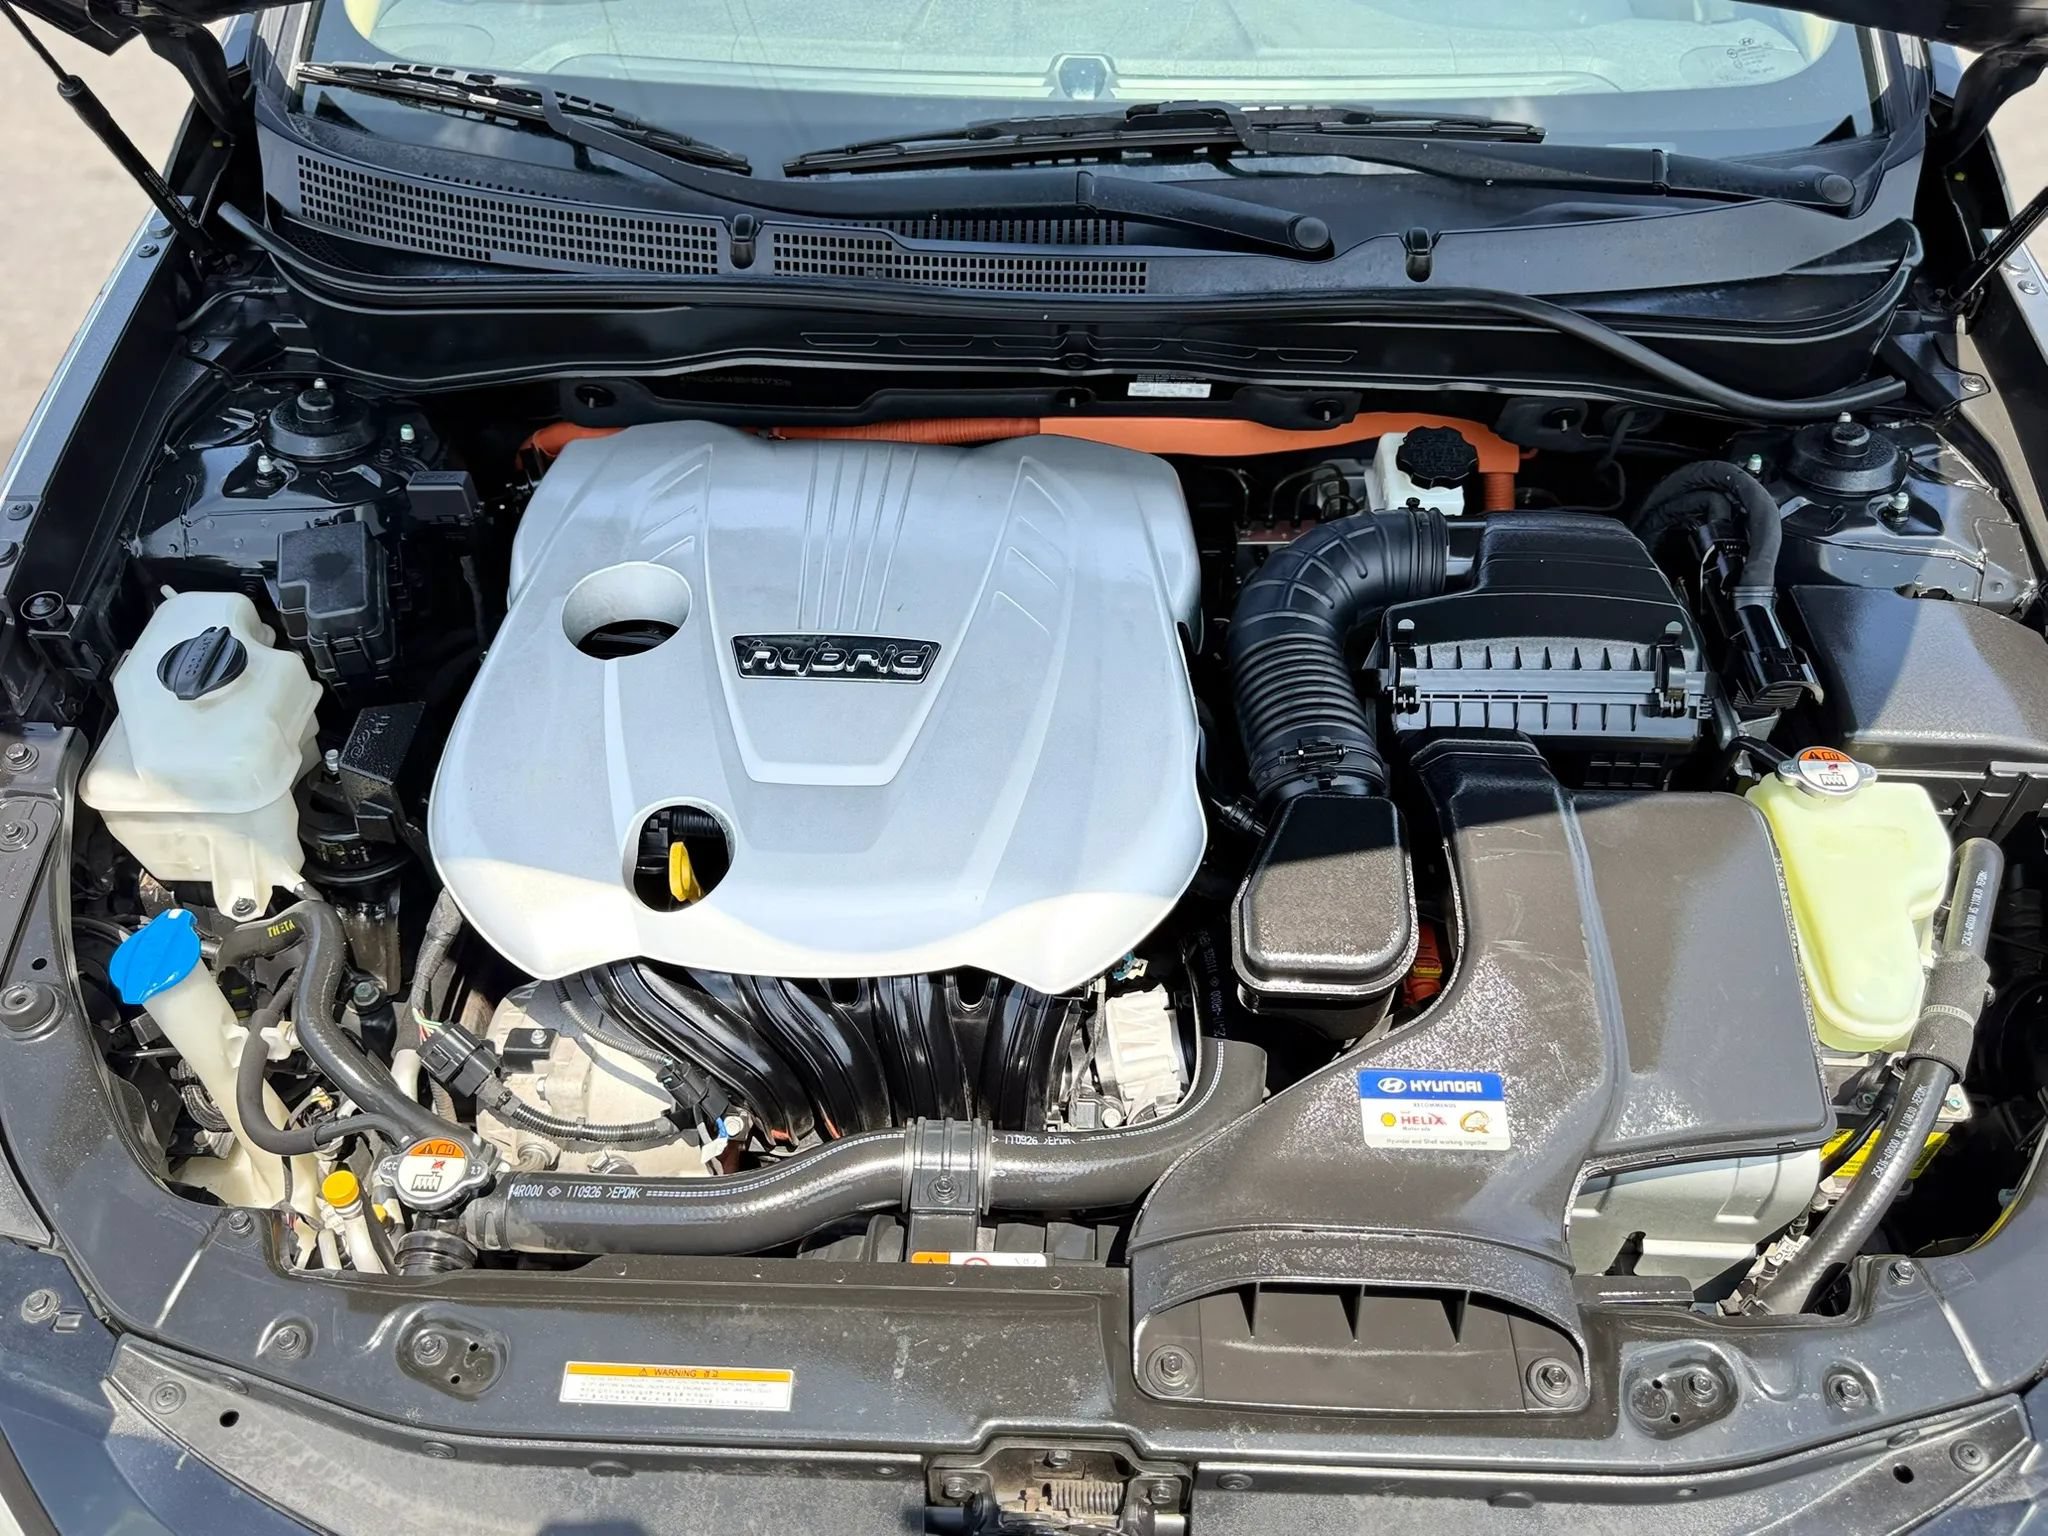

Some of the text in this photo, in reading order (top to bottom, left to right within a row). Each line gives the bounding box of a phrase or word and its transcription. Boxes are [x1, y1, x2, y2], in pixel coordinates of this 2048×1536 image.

[742, 639, 933, 677] hybrid
[267, 919, 296, 938] THETA
[1410, 1080, 1483, 1093] HYUNDAI
[1400, 1112, 1445, 1126] HELIX
[567, 1185, 602, 1198] 110926
[655, 1368, 697, 1378] WARNING
